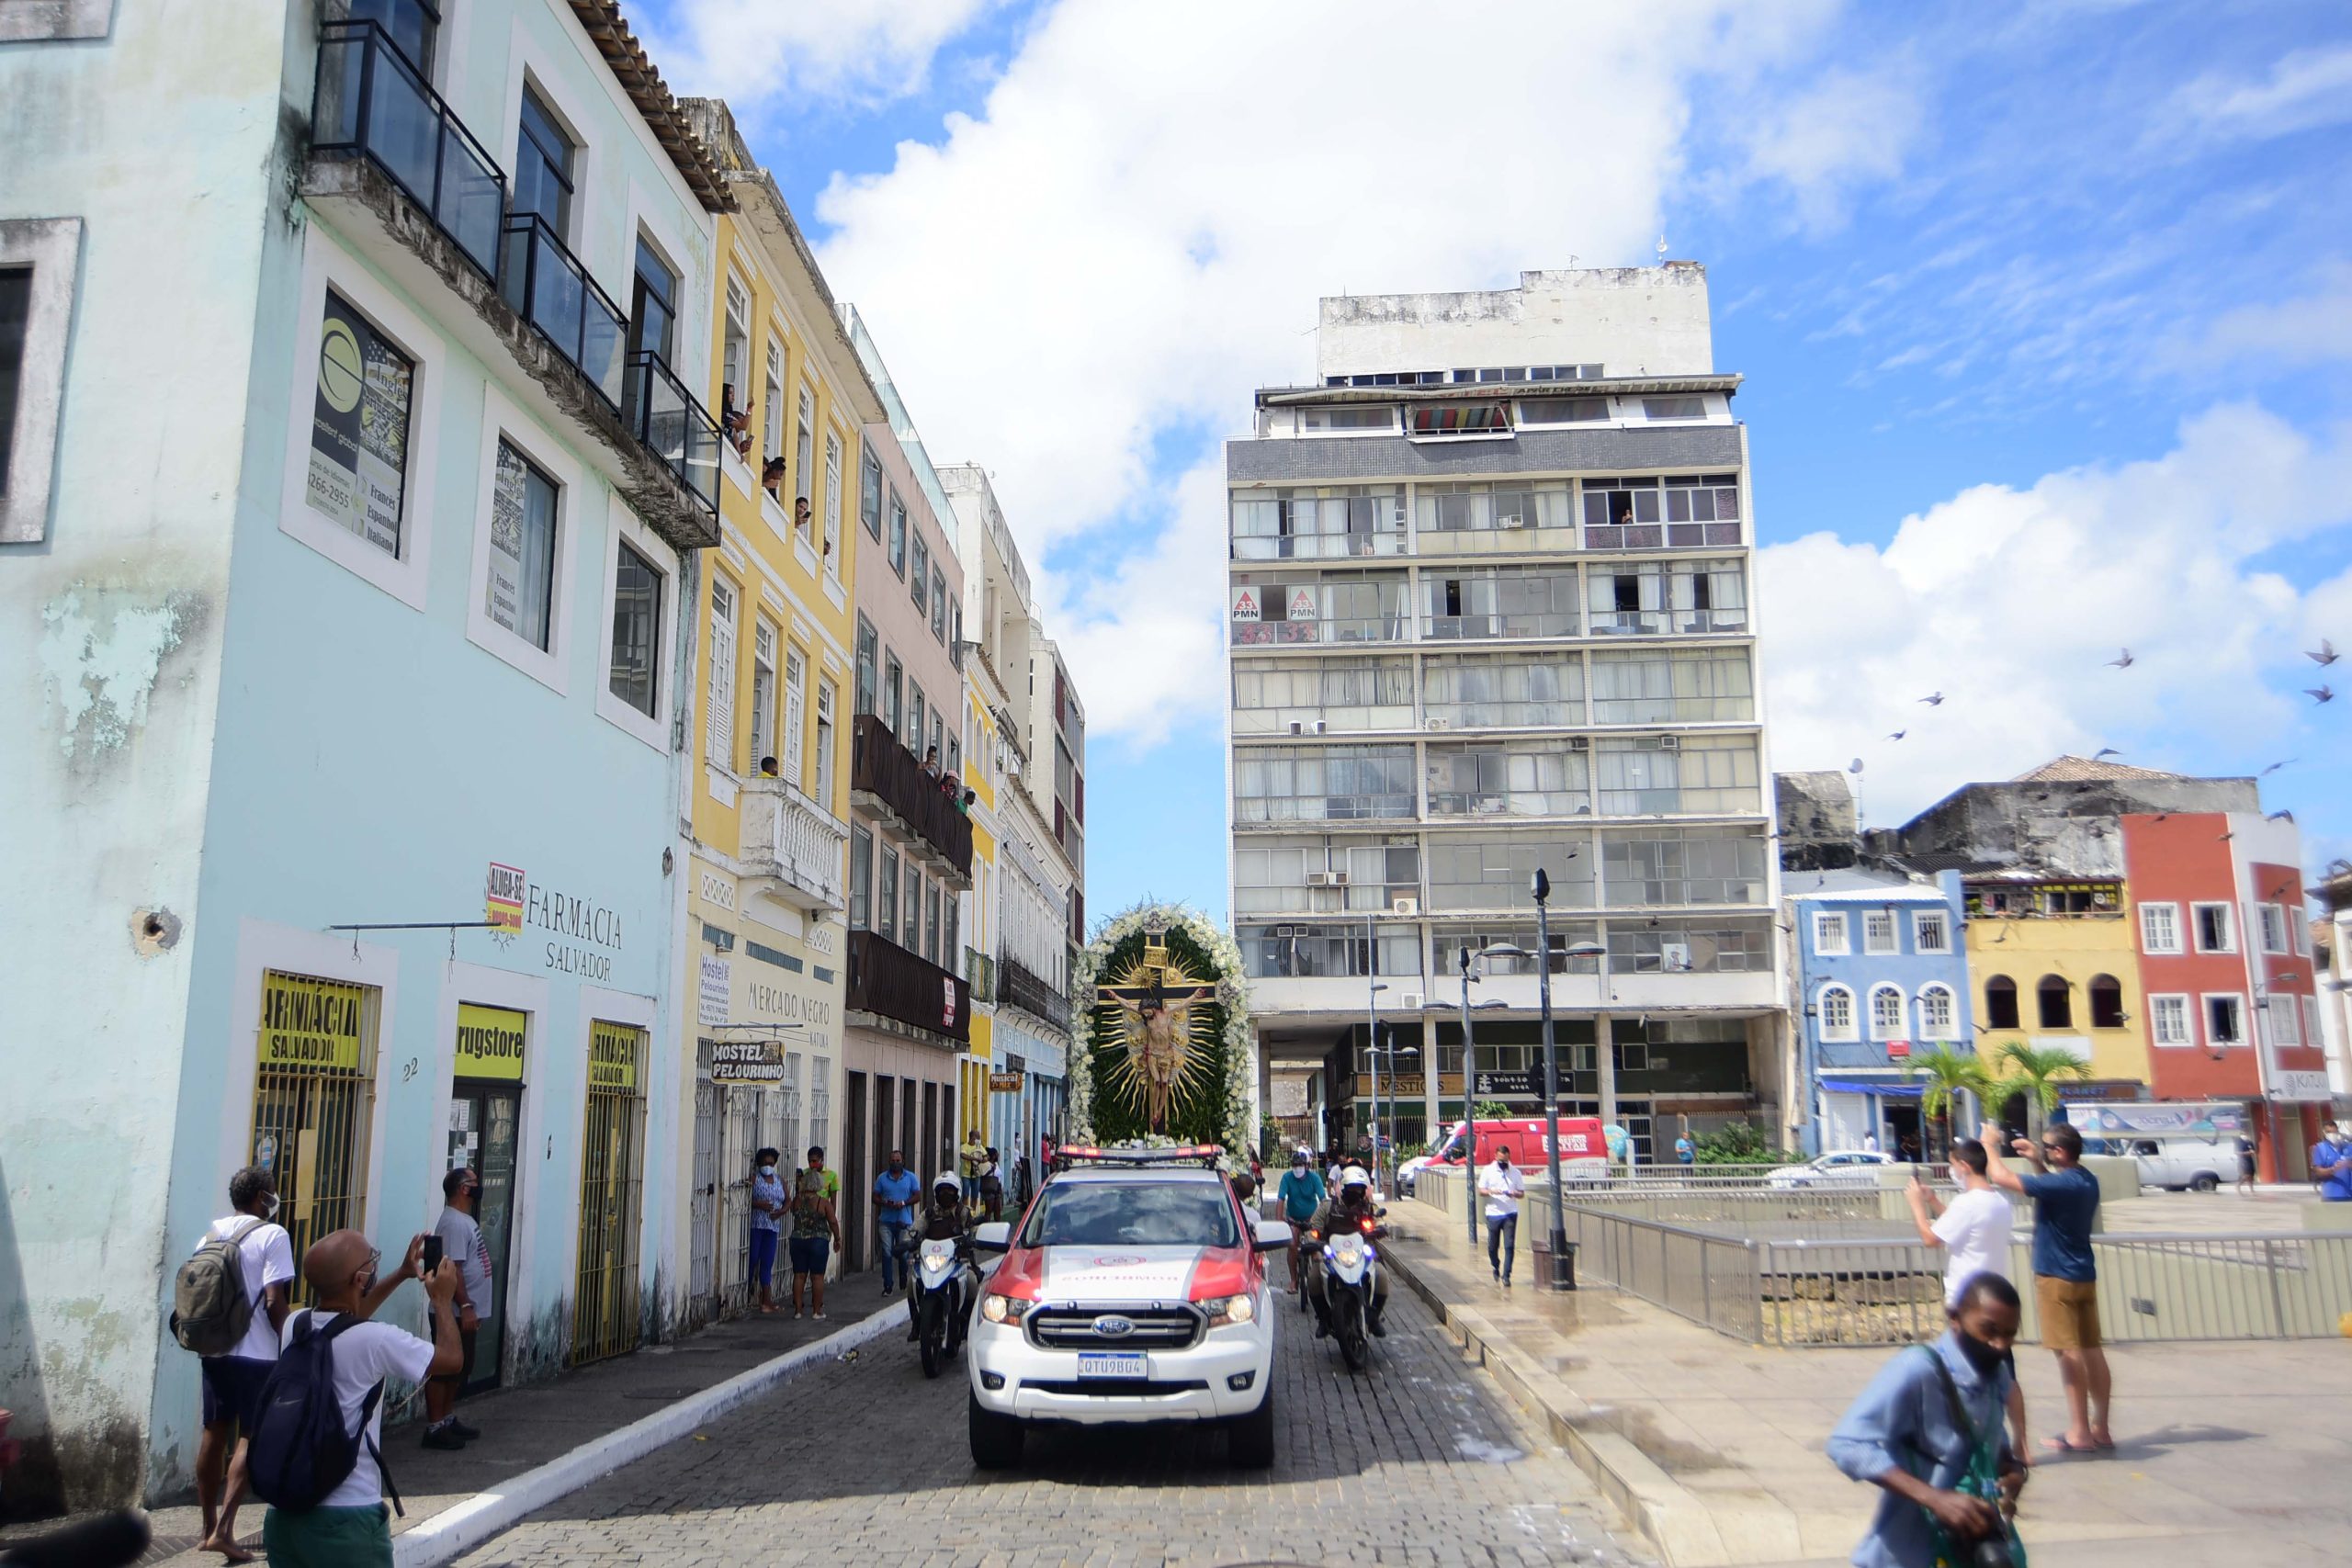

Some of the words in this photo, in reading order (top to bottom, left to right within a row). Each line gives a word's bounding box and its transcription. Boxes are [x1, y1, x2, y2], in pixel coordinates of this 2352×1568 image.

[368, 504, 398, 534] Espanhol
[368, 526, 394, 553] Italiano
[1233, 610, 1259, 618] PMN
[1239, 601, 1253, 610] 33
[1290, 608, 1316, 617] PMN
[1295, 599, 1309, 608] 33
[490, 867, 523, 901] ALUGA-SE
[526, 884, 622, 950] FARMÁCIA
[545, 942, 611, 983] SALVADOR
[701, 955, 725, 982] Hostel
[701, 979, 729, 996] Pelourinho
[265, 986, 357, 1037] ARMÁCIA
[748, 982, 797, 1019] MERCADO
[801, 997, 830, 1026] NEGRO
[271, 1034, 334, 1062] SAVADOR
[457, 1025, 523, 1059] rugstore
[712, 1043, 763, 1062] HOSTEL
[403, 1056, 419, 1082] 22
[712, 1063, 785, 1080] PELOURINHO
[990, 1074, 1018, 1082] Musical
[1381, 1081, 1444, 1093] MESTIÇS
[1085, 1360, 1140, 1374] QTU9B04
